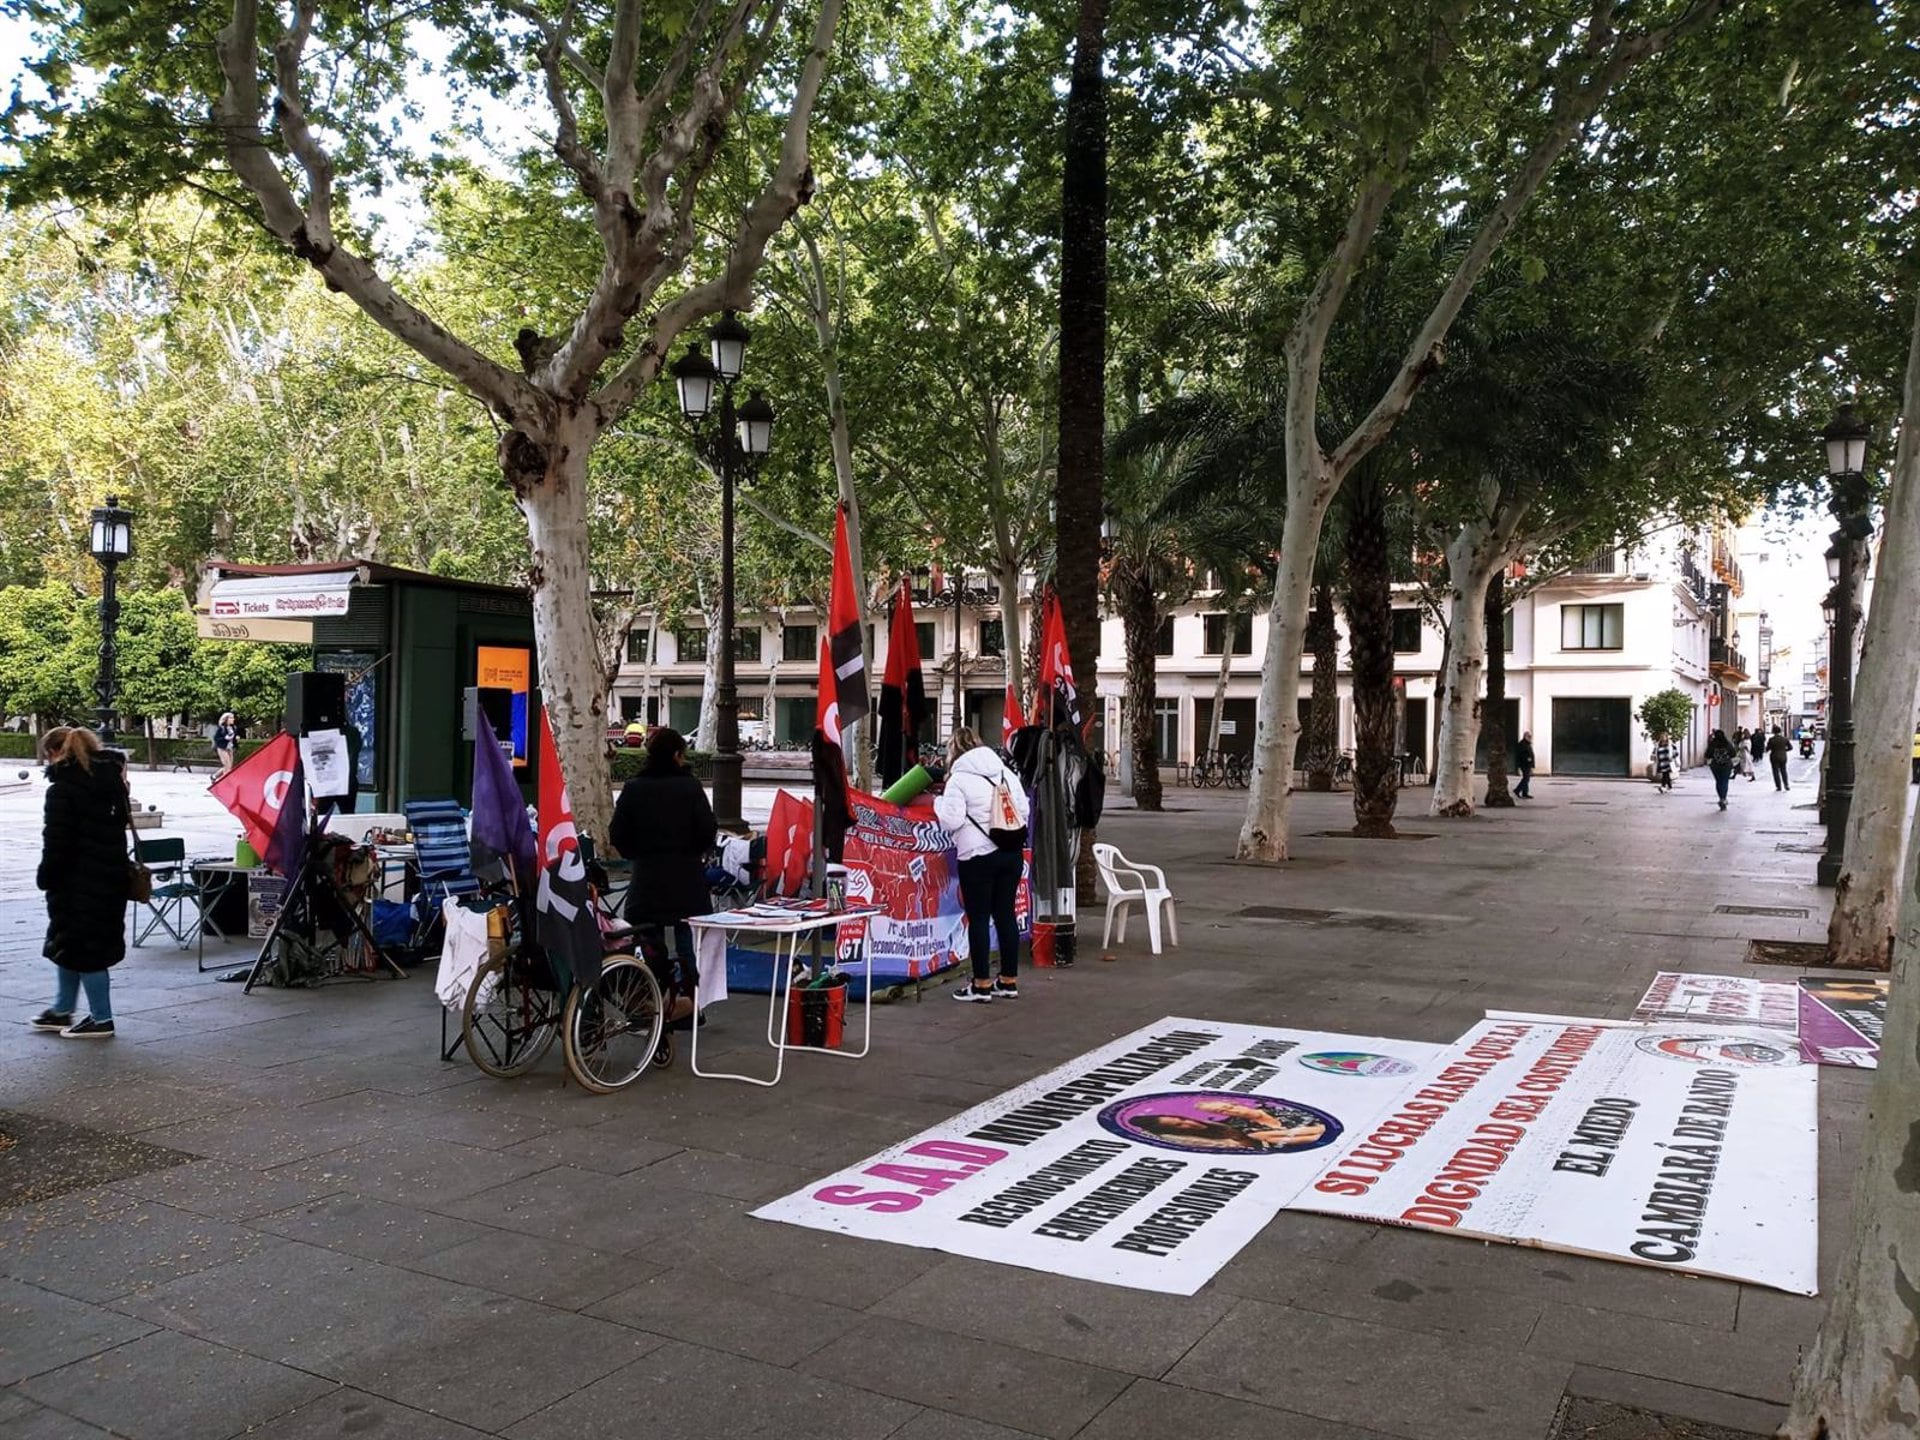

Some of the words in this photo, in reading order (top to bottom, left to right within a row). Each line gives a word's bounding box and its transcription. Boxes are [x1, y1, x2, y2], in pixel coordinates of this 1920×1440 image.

[243, 602, 270, 613] Tickets
[1465, 1036, 1519, 1061] QUE
[1487, 1025, 1533, 1038] LA
[1415, 1061, 1497, 1103] HASTA
[1516, 1025, 1605, 1092] COSTUMBRE
[1490, 1094, 1553, 1123] SEA
[1683, 1069, 1736, 1117] BANDO
[813, 1141, 1009, 1213] S.A.D
[965, 1030, 1223, 1147] MUNICIPALIZACIÓN
[1339, 1102, 1450, 1173] LUCHAS
[1568, 1097, 1639, 1150] MIEDO
[1672, 1116, 1725, 1142] DE
[957, 1139, 1132, 1229] RECONOCIMIENTO
[1315, 1172, 1379, 1196] SI
[1399, 1123, 1527, 1228] DIGNIDAD
[1552, 1151, 1616, 1178] EL
[1031, 1156, 1189, 1242] EMFERMEDADES
[1111, 1167, 1260, 1257] PROFESIONALES
[1629, 1142, 1722, 1263] CAMBIARÁ
